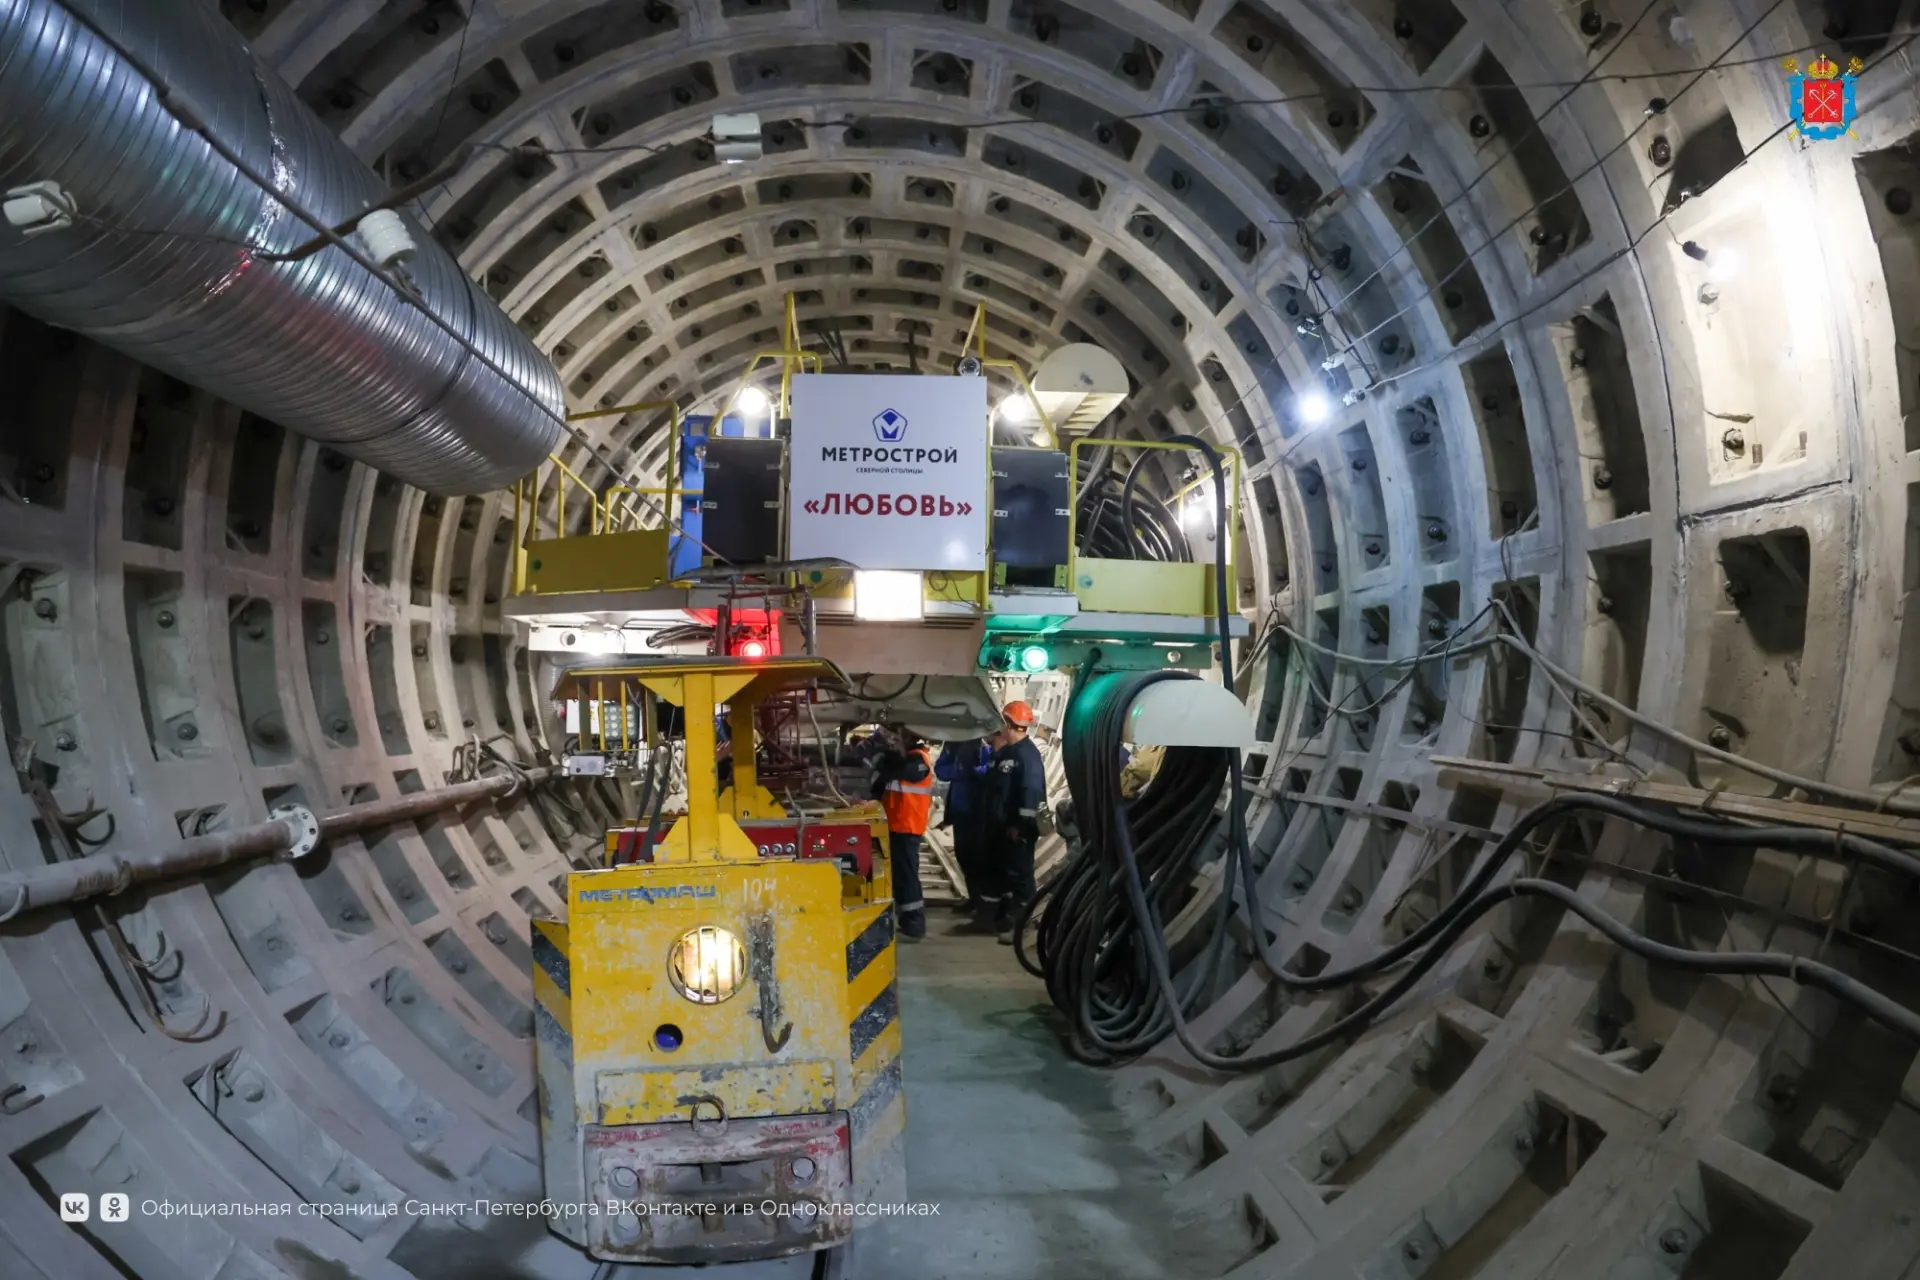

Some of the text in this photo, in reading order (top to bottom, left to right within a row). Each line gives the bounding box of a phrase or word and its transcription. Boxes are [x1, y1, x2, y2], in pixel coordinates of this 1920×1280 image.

[821, 446, 958, 464] МЕТРОСТРОЙ
[856, 466, 924, 475] СЕВЕРНОЙ СТОЛИЦЫ
[803, 493, 973, 517] «ЛЮБОВЬ»
